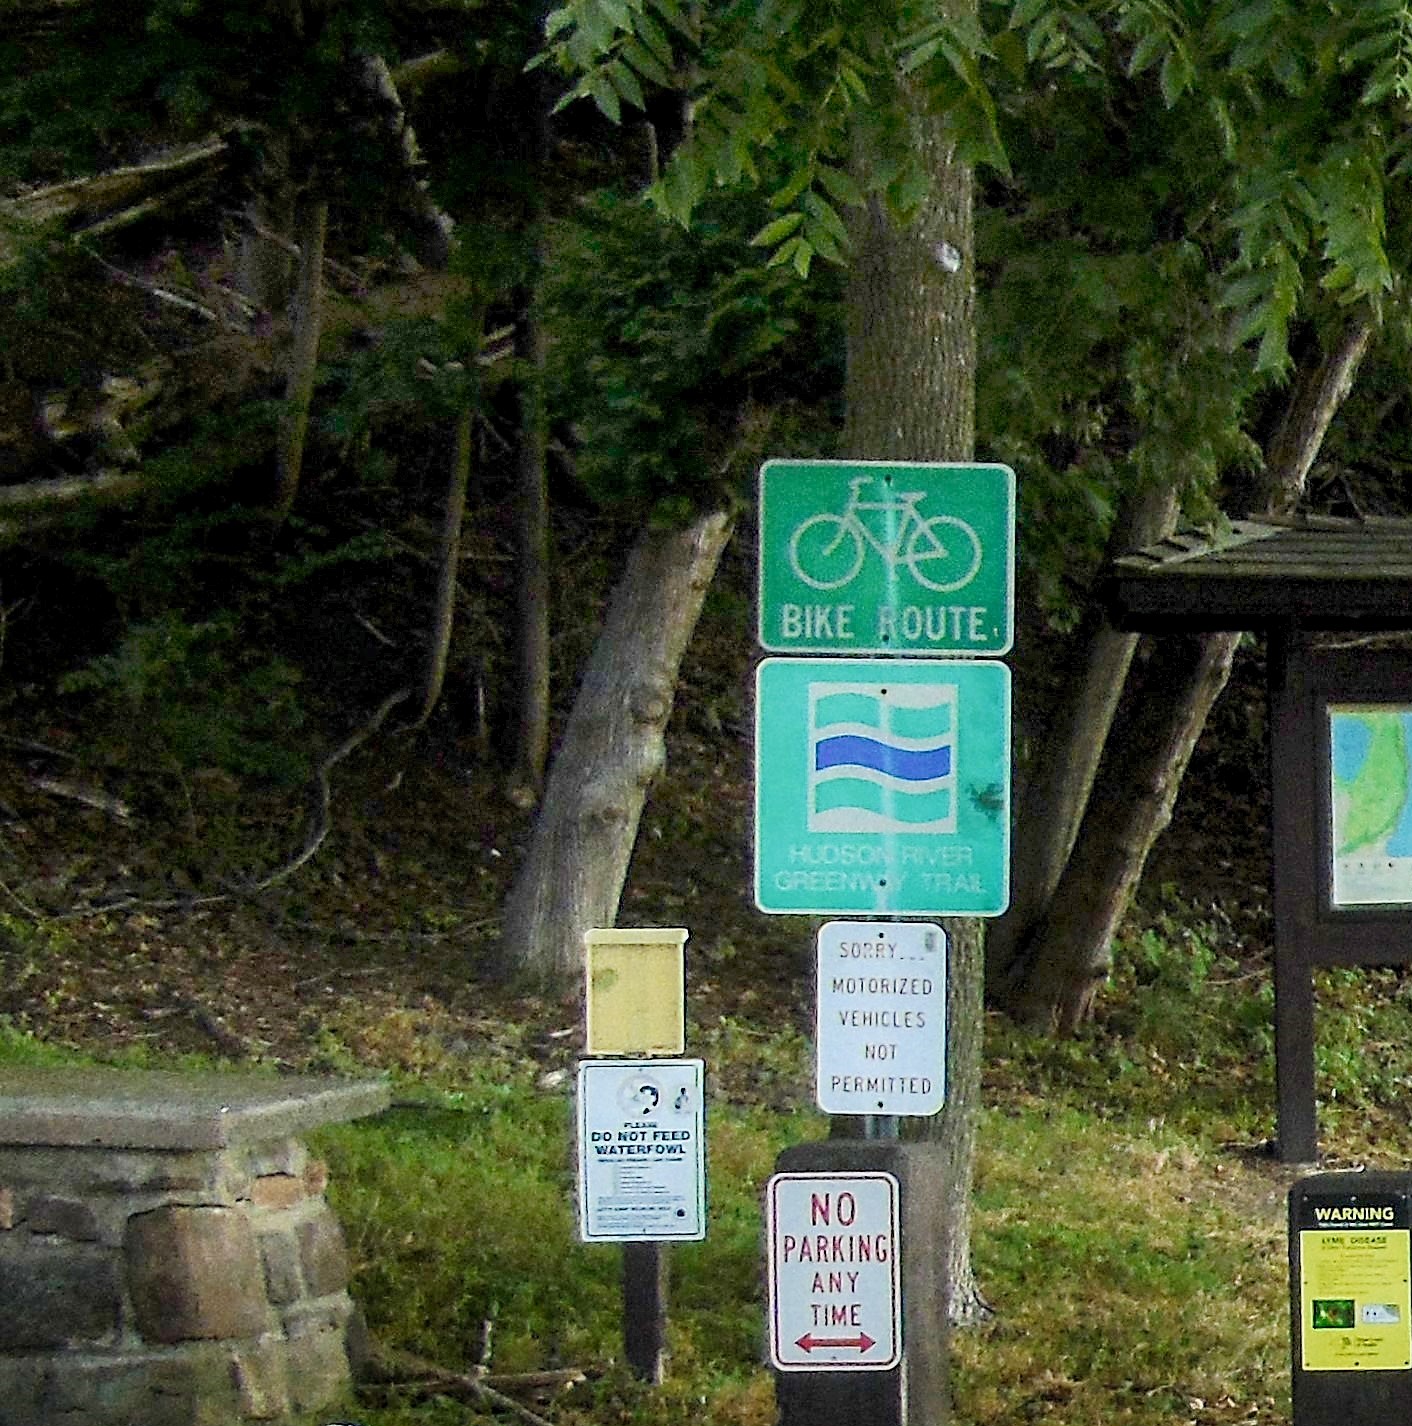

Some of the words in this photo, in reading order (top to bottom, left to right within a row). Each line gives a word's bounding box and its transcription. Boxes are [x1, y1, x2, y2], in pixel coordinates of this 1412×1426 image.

[782, 604, 854, 638] BIKE
[880, 607, 988, 641] ROUTE
[903, 846, 972, 864] RIVER
[833, 979, 932, 995] MOTORIZED
[839, 1012, 926, 1027] VEHICLES
[864, 1044, 896, 1060] NOT
[832, 1077, 931, 1094] PERMITTED
[592, 1132, 611, 1141] DO
[618, 1132, 646, 1141] NOT
[653, 1131, 690, 1140] FEED
[595, 1145, 686, 1154] WATERFOWL
[811, 1193, 856, 1225] NO
[1315, 1207, 1394, 1221] WARNING
[784, 1235, 888, 1263] PARKING
[811, 1273, 859, 1293] ANY
[811, 1305, 862, 1326] TIME
